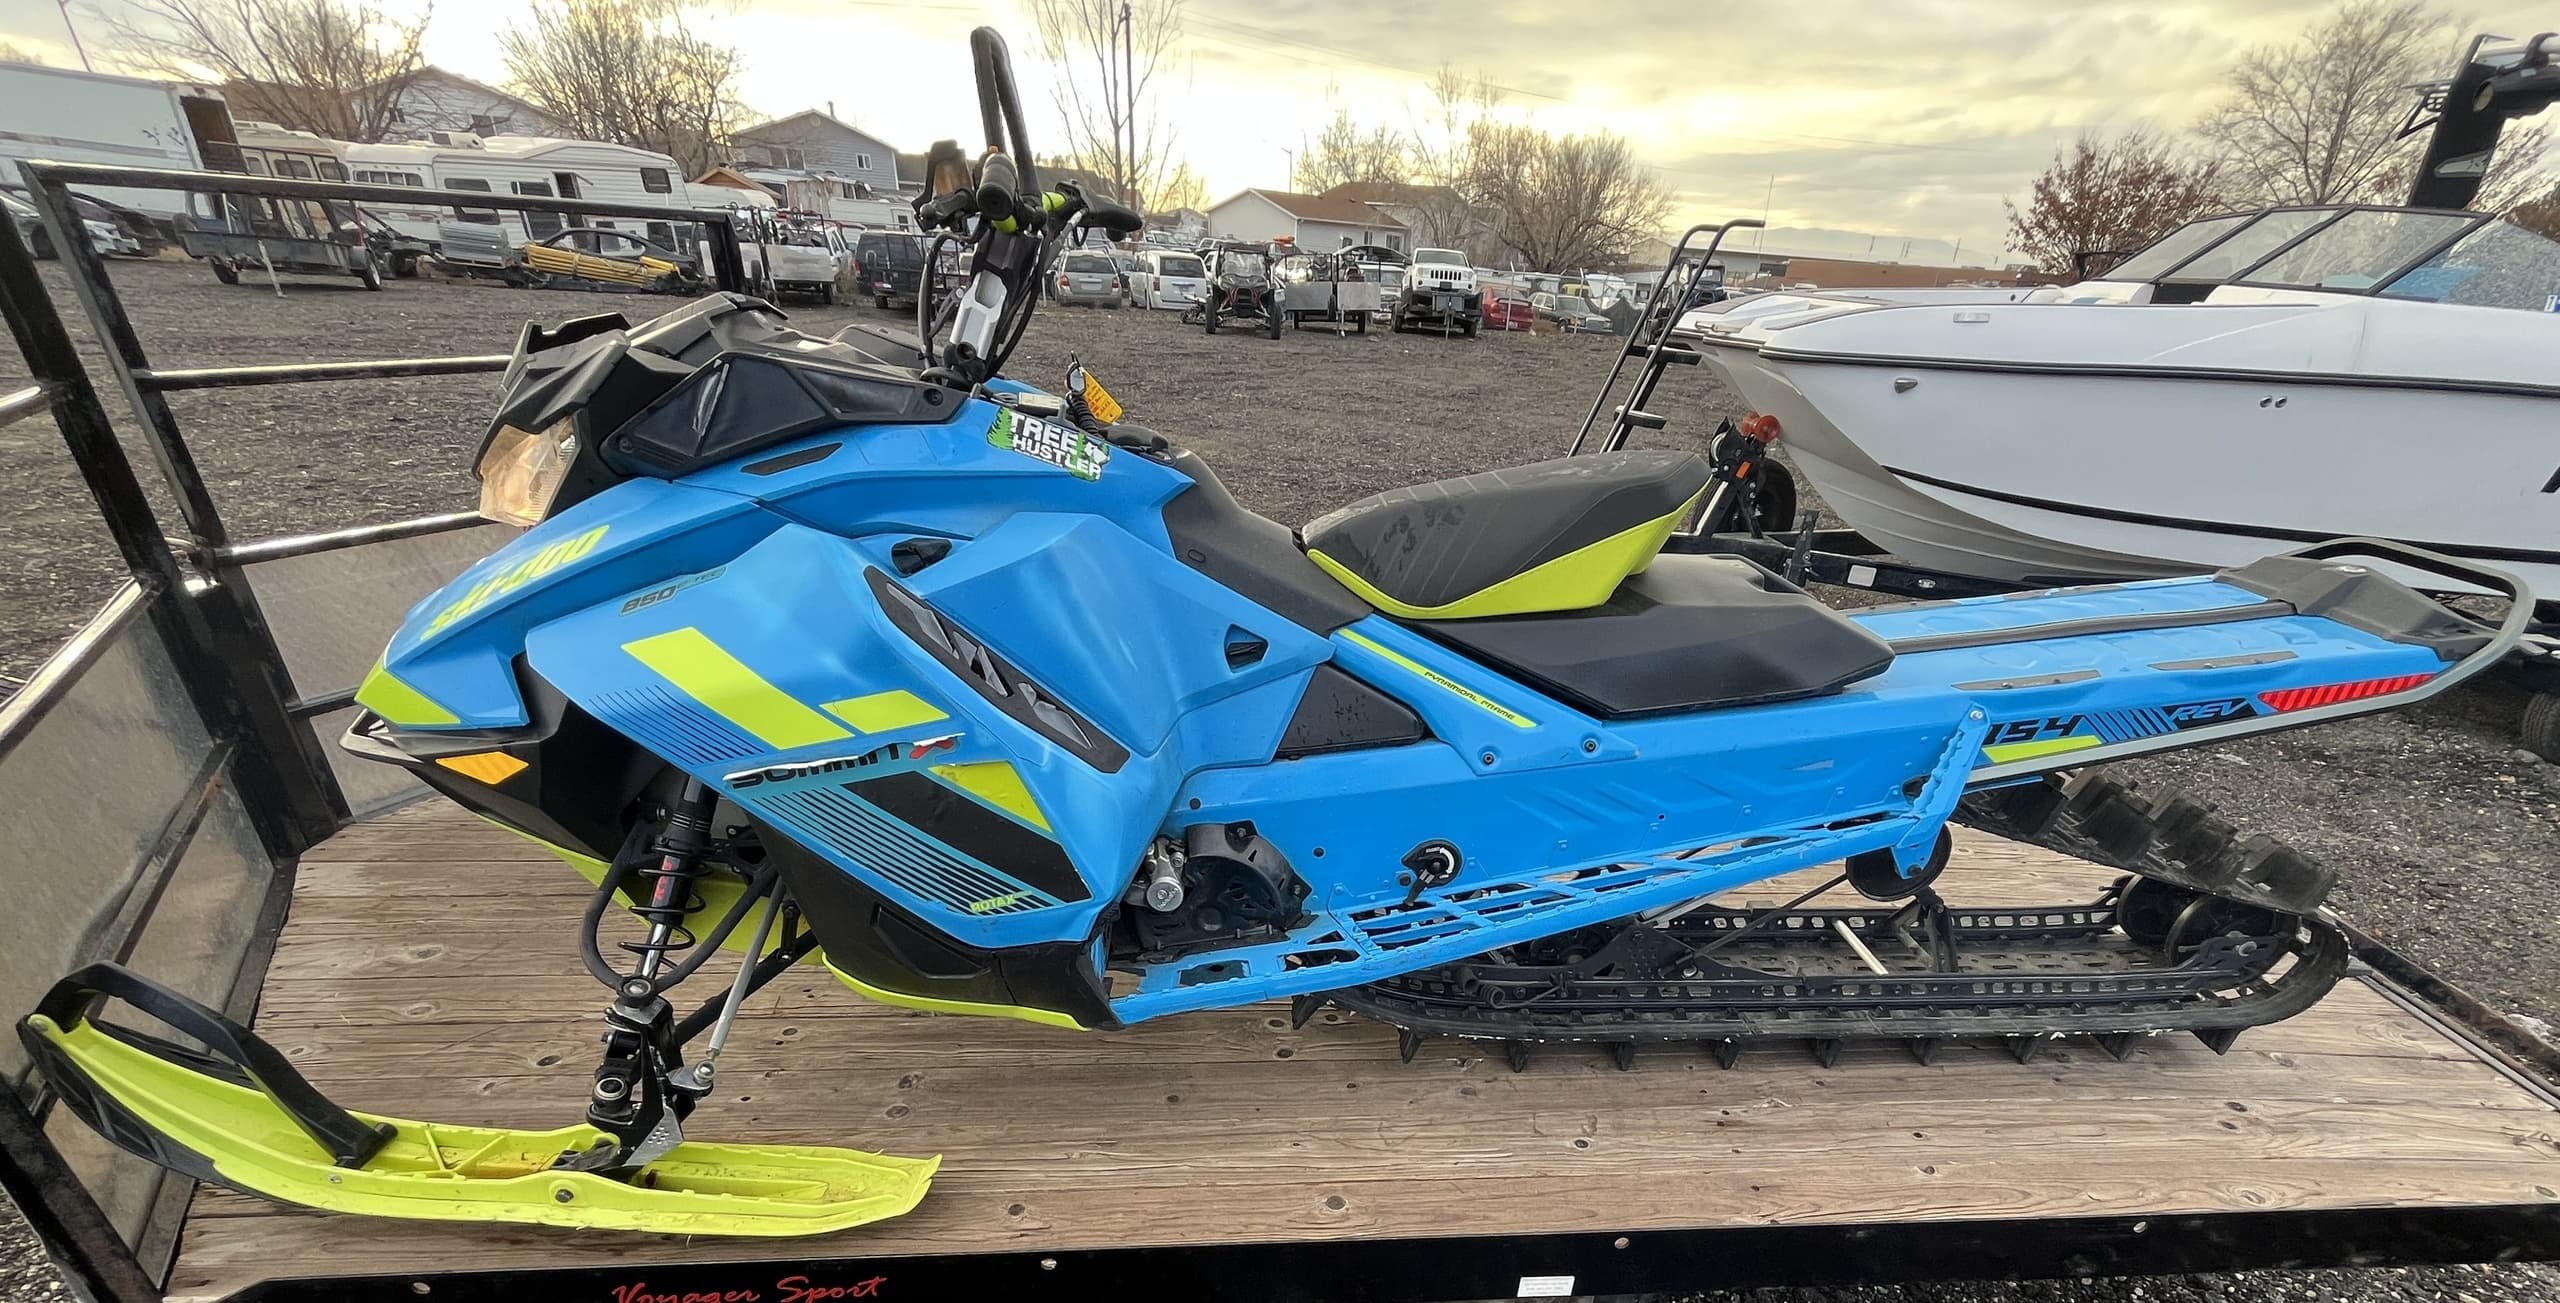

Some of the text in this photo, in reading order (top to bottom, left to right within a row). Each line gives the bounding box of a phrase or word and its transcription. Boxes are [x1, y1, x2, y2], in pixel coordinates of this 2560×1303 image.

[1009, 410, 1080, 455] TREE
[1012, 433, 1102, 480] HUSTLER
[621, 585, 677, 613] 850
[1424, 671, 1478, 702] PYRAMIDAL
[1983, 699, 2249, 746] 154 REV
[969, 893, 1017, 913] ROTAX
[611, 1275, 888, 1303] Voyager Sport
